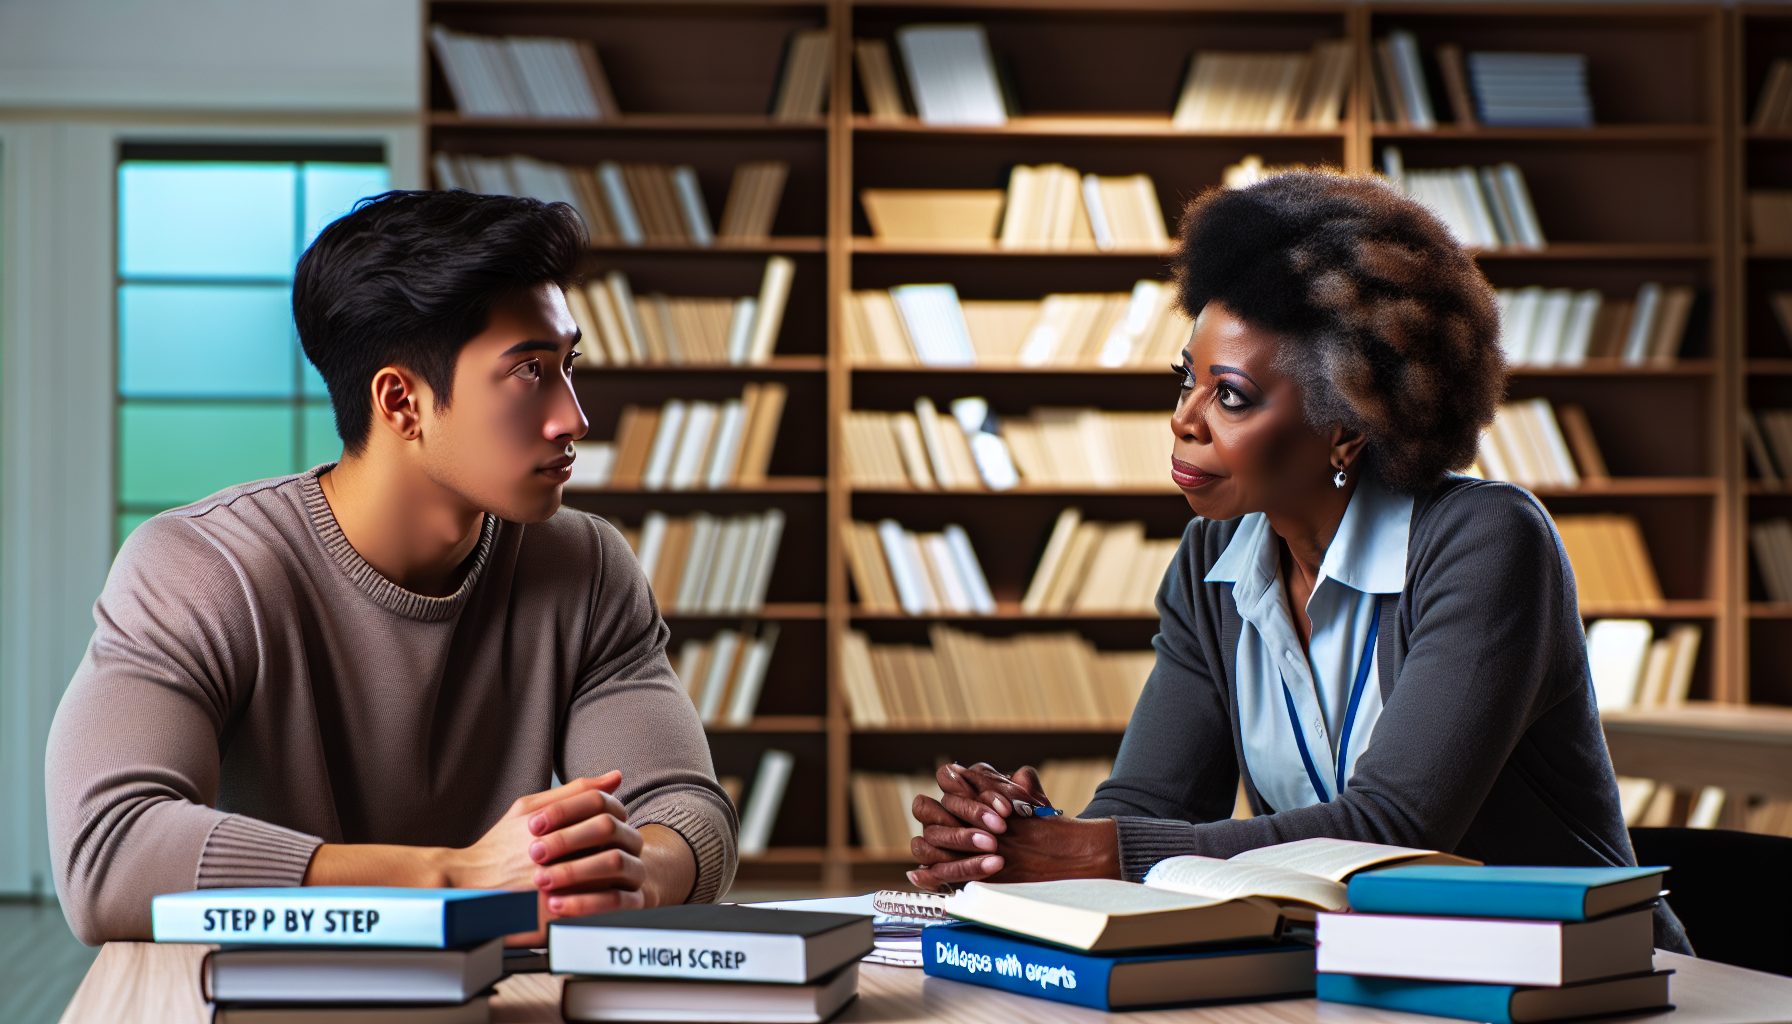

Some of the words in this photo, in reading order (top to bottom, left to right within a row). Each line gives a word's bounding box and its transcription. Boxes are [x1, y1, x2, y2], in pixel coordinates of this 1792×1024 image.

[203, 908, 256, 932] STEP
[285, 909, 314, 933] BY
[324, 909, 380, 933] STEP
[607, 946, 633, 965] TO
[688, 948, 746, 969] SCREP
